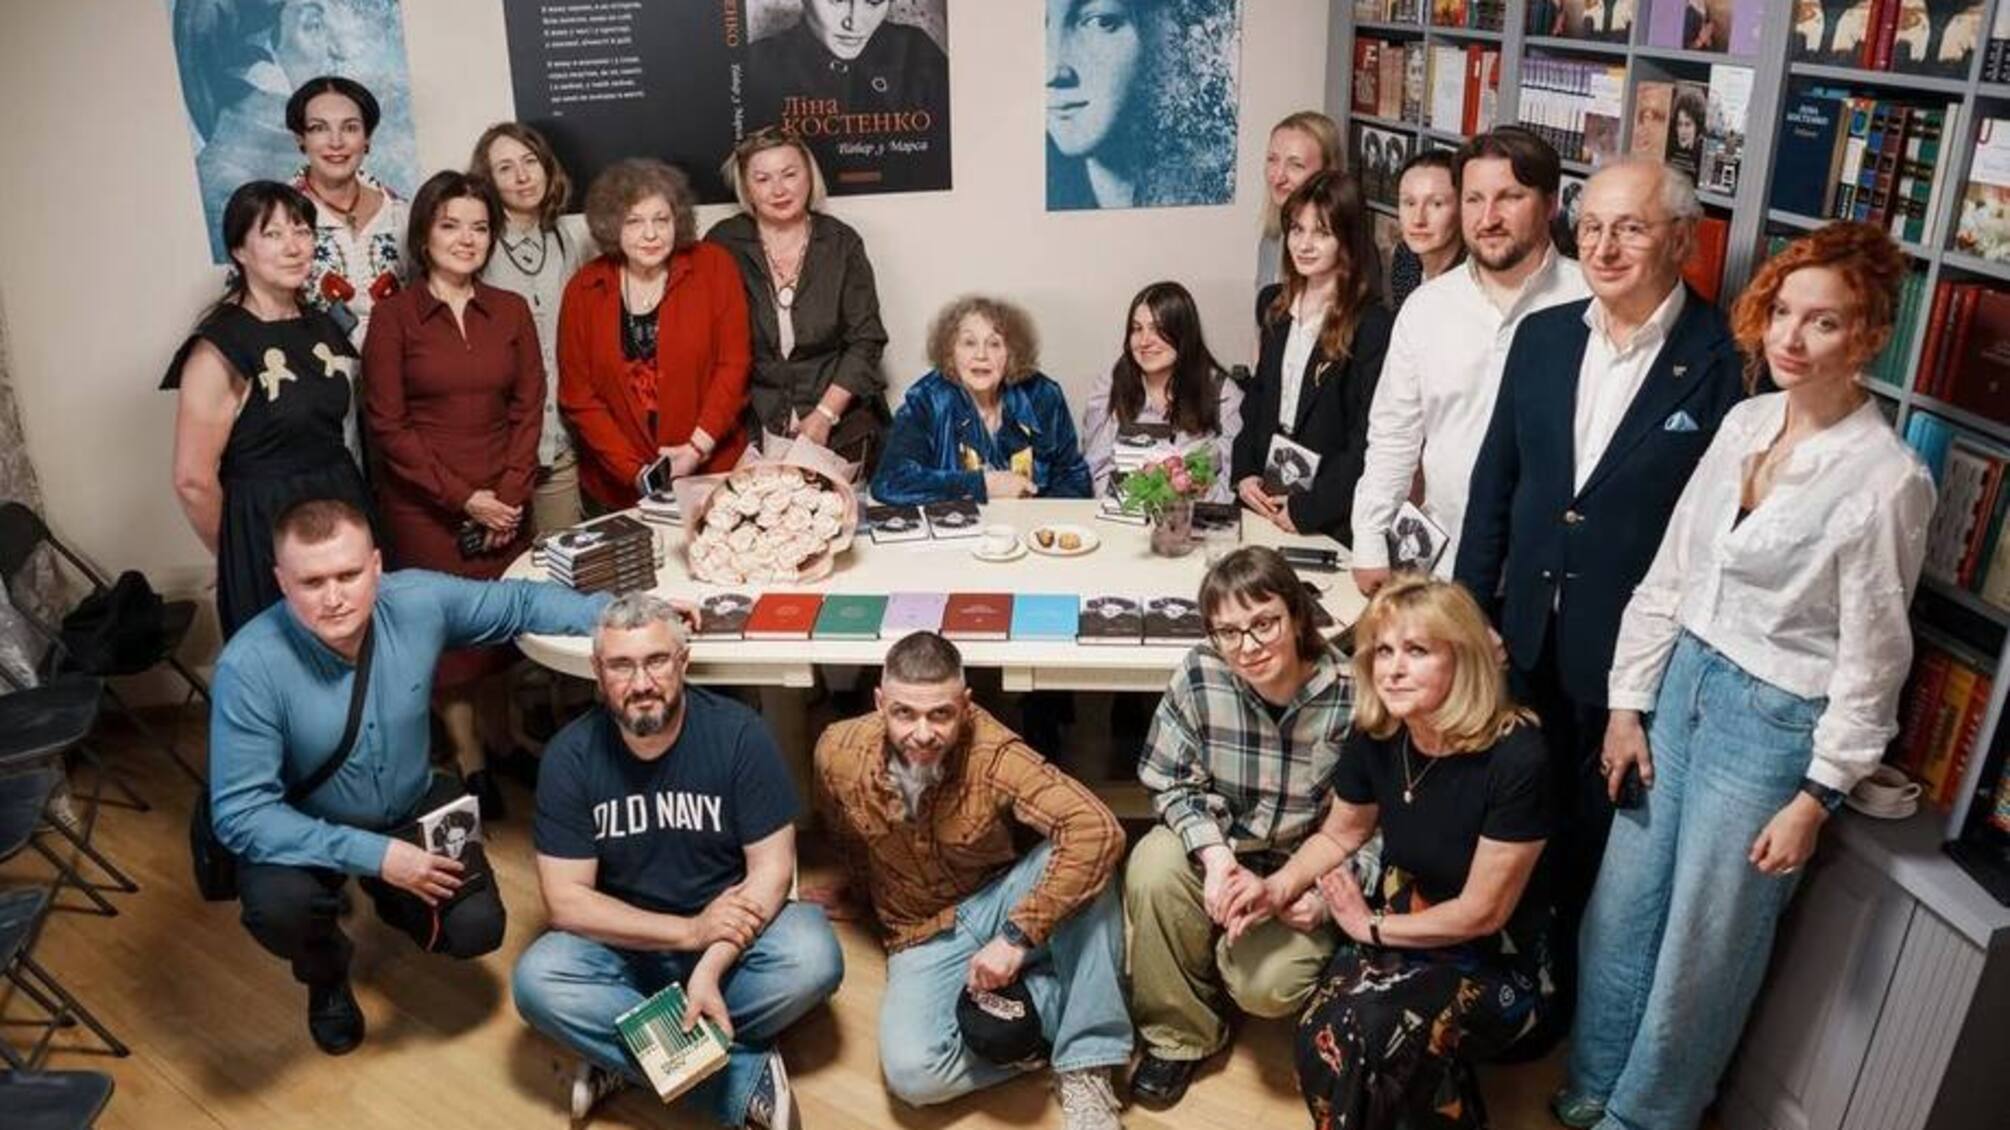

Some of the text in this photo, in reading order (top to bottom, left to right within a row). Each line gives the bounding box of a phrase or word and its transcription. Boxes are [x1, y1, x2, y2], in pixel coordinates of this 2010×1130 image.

[781, 96, 840, 117] Ліна
[780, 110, 932, 136] КОСТЕНКО
[592, 791, 721, 840] OLD NAVY
